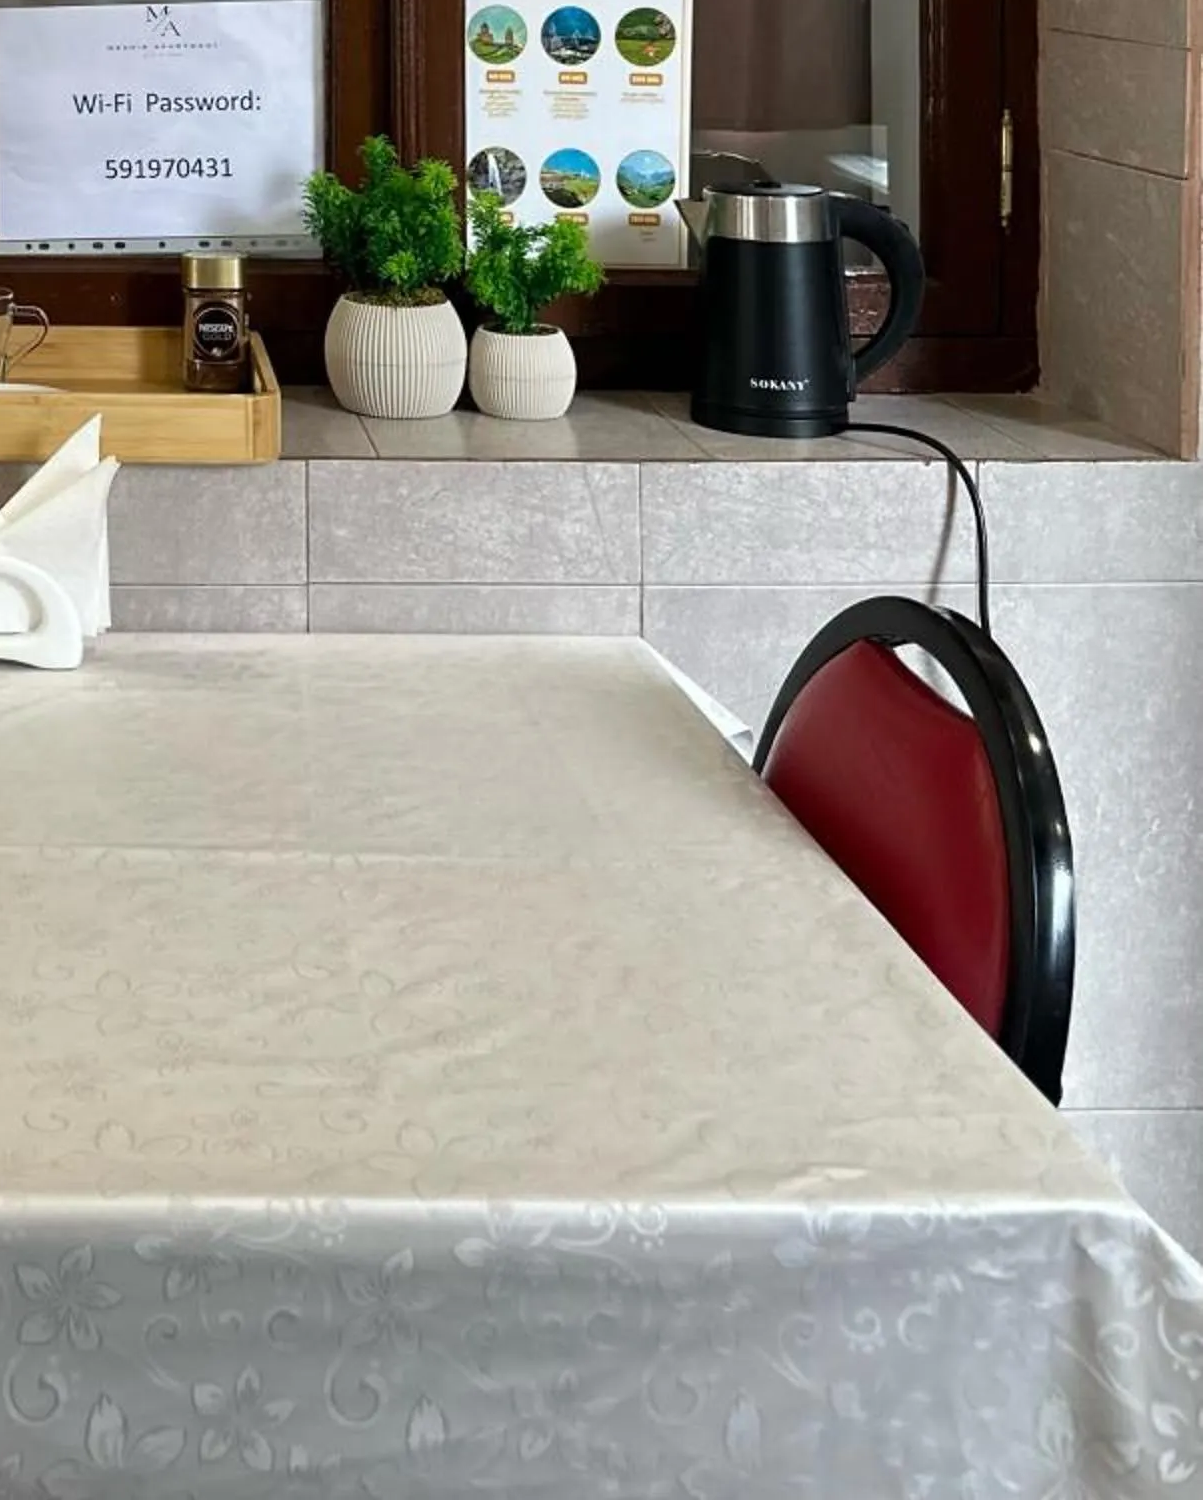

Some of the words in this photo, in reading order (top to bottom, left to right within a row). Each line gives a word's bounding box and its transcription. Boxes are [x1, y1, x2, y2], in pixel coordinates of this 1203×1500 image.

[73, 93, 132, 114] Wi-Fi
[146, 89, 261, 113] Password:
[105, 157, 234, 179] 591970431
[750, 377, 805, 392] SOKANY
